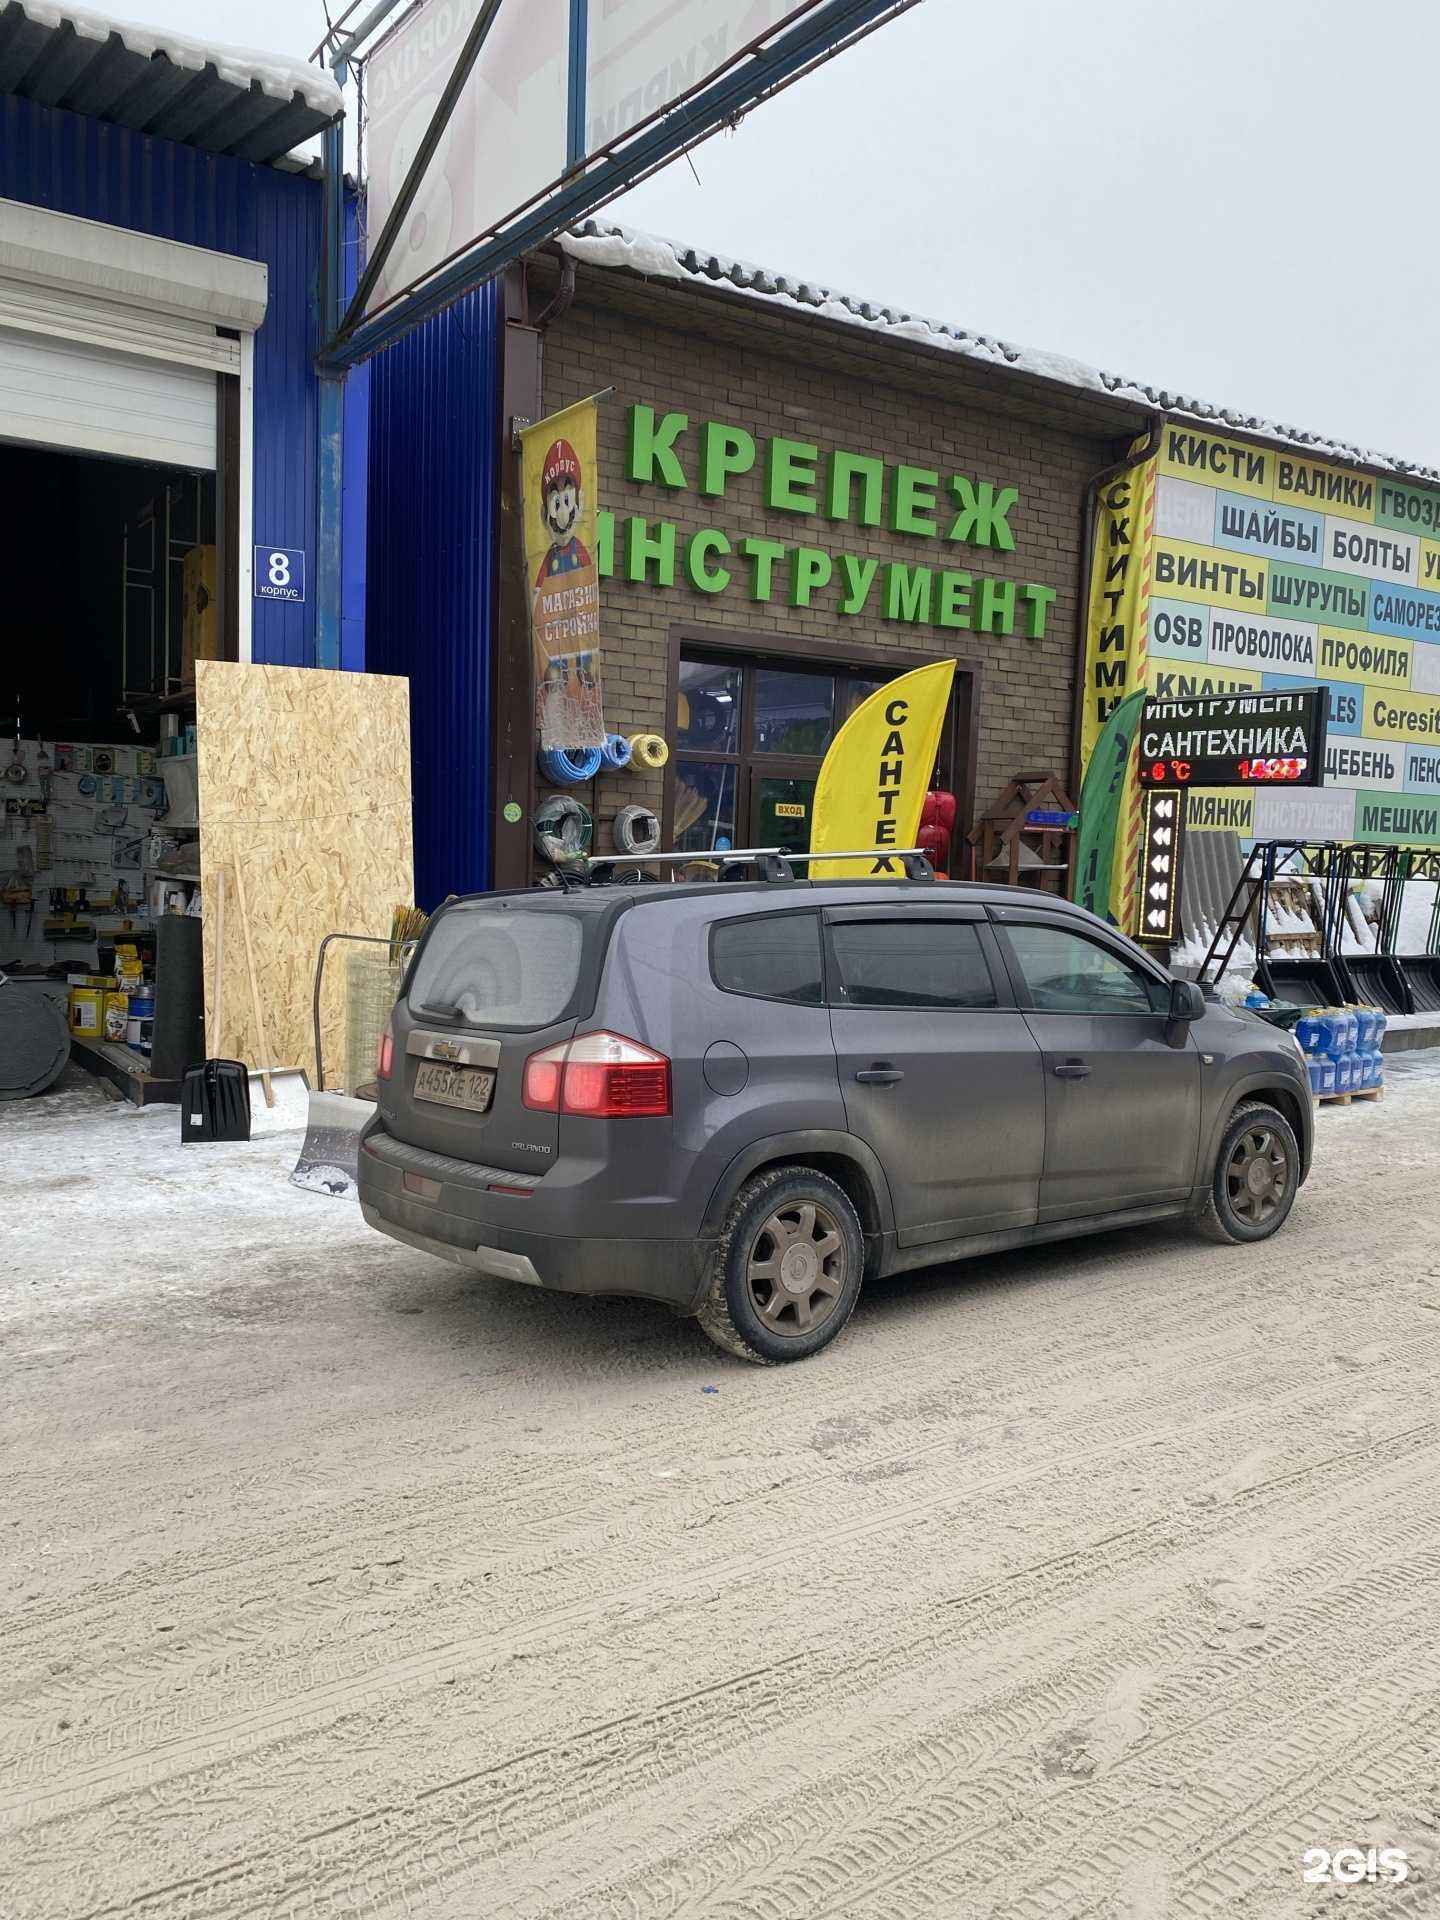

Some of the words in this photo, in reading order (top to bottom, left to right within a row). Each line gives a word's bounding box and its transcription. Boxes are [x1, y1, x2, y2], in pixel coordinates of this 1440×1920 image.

[627, 404, 1019, 551] КРЕПЕЖ
[1168, 431, 1265, 485] КИСТИ
[1279, 461, 1372, 510] ВАЛИКИ
[1222, 505, 1318, 553] ШАЙБЫ
[1333, 531, 1411, 573] БОЛТЫ
[269, 552, 290, 586] 8
[1156, 552, 1265, 601] ВИНТЫ
[1272, 575, 1366, 617] ШУРУПЫ
[261, 585, 299, 598] корпус
[1154, 613, 1203, 648] OSB
[1212, 621, 1313, 665] ПРОВОЛОКА
[1321, 639, 1408, 678] ПРОФИЛЯ
[1143, 726, 1308, 757] САНТЕХНИКА
[778, 805, 802, 816] ВХОД
[1141, 796, 1252, 828] МЯНКИ
[1363, 806, 1437, 835] МЕШКИ
[511, 1141, 552, 1155] ORLANDO
